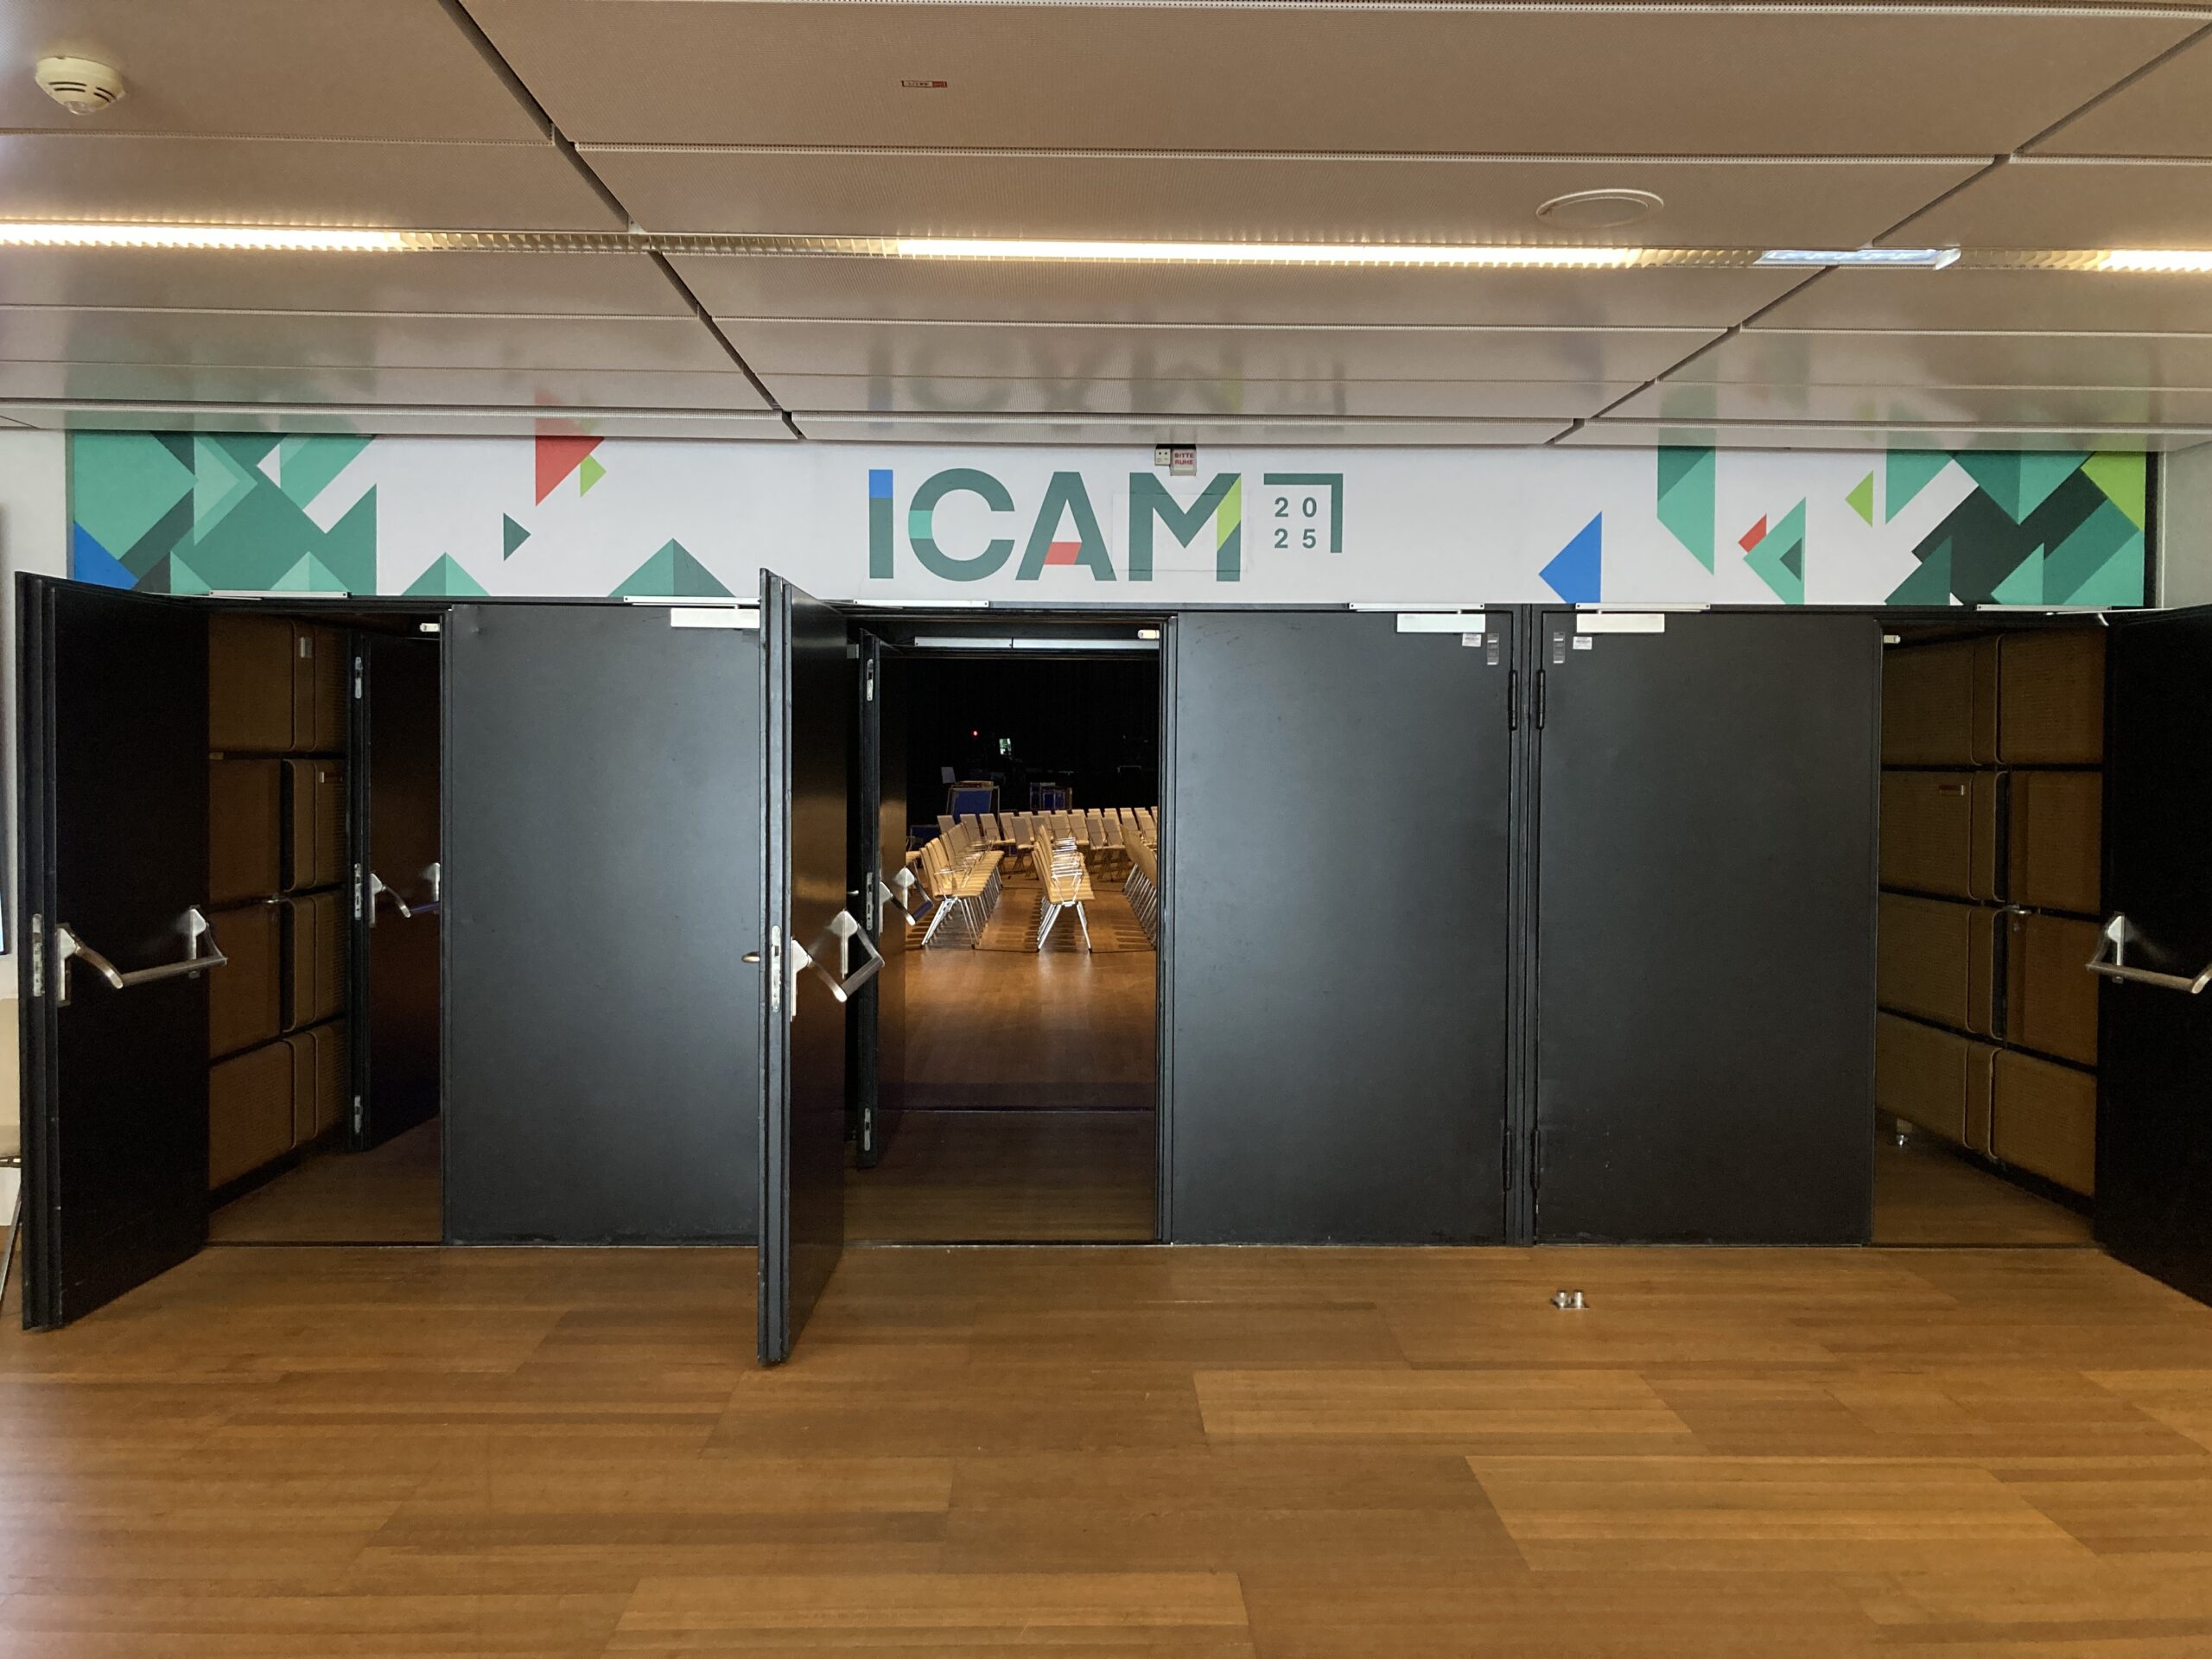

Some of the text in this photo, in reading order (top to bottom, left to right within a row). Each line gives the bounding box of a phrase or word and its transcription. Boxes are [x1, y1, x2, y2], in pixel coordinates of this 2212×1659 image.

[1274, 497, 1317, 518] 20
[869, 468, 1242, 582] ICAM
[1274, 528, 1316, 549] 25
